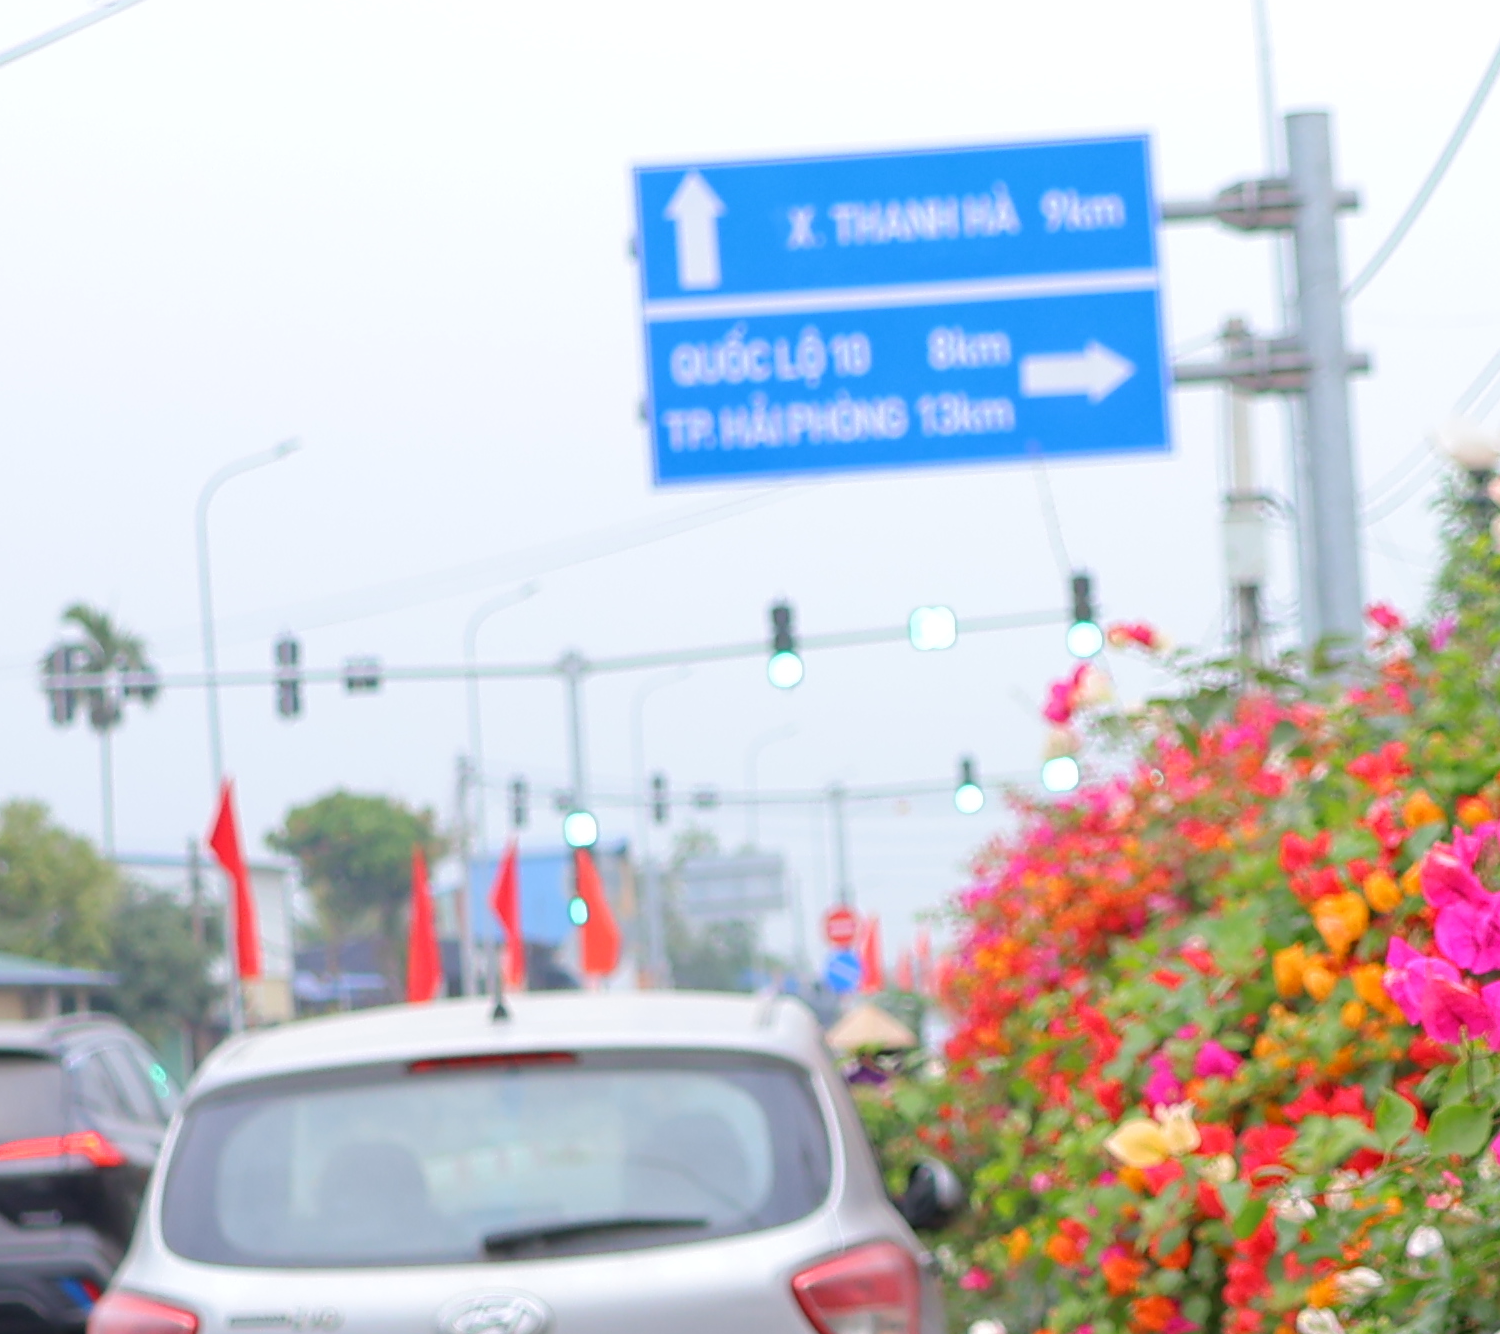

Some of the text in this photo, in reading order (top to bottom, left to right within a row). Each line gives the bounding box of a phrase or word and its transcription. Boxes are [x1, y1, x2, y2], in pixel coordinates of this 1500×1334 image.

[828, 196, 959, 246] THANH
[961, 180, 1021, 238] HÀ
[670, 320, 772, 386] QUỐC
[773, 326, 826, 388] LỘ
[927, 326, 1011, 371] 8km
[718, 391, 784, 450] HẢI
[785, 389, 909, 445] PHÒNG
